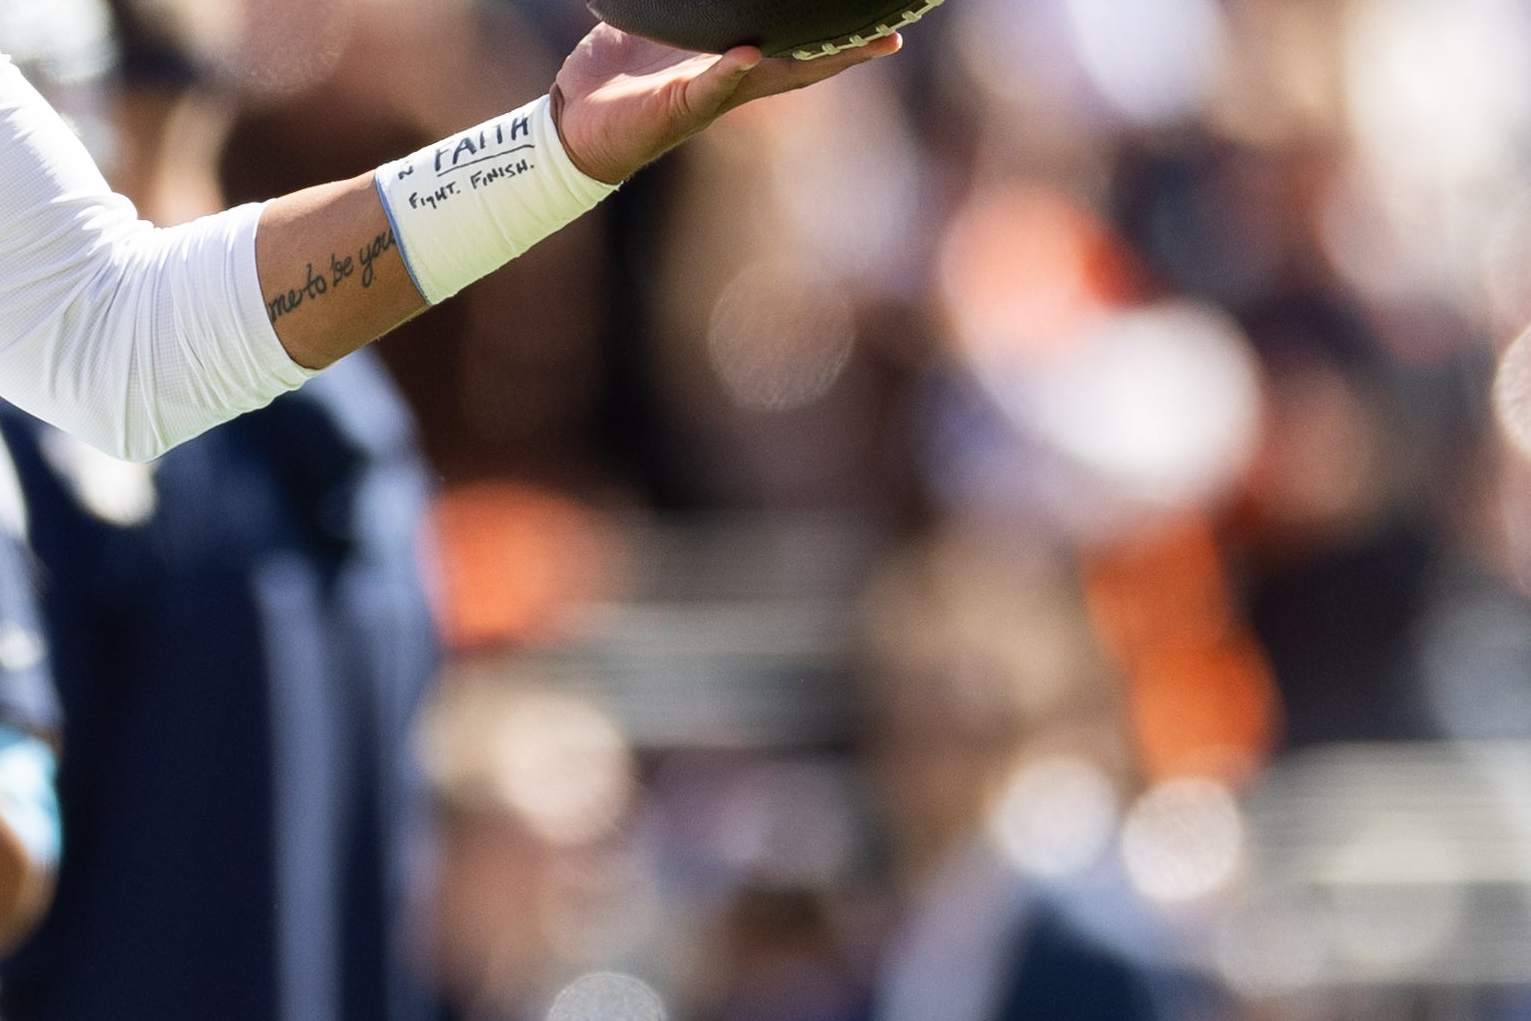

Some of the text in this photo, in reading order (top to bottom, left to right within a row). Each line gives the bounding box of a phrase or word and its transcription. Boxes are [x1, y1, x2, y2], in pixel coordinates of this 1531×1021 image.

[434, 114, 529, 172] FAITH
[302, 262, 328, 300] to
[329, 252, 354, 288] be
